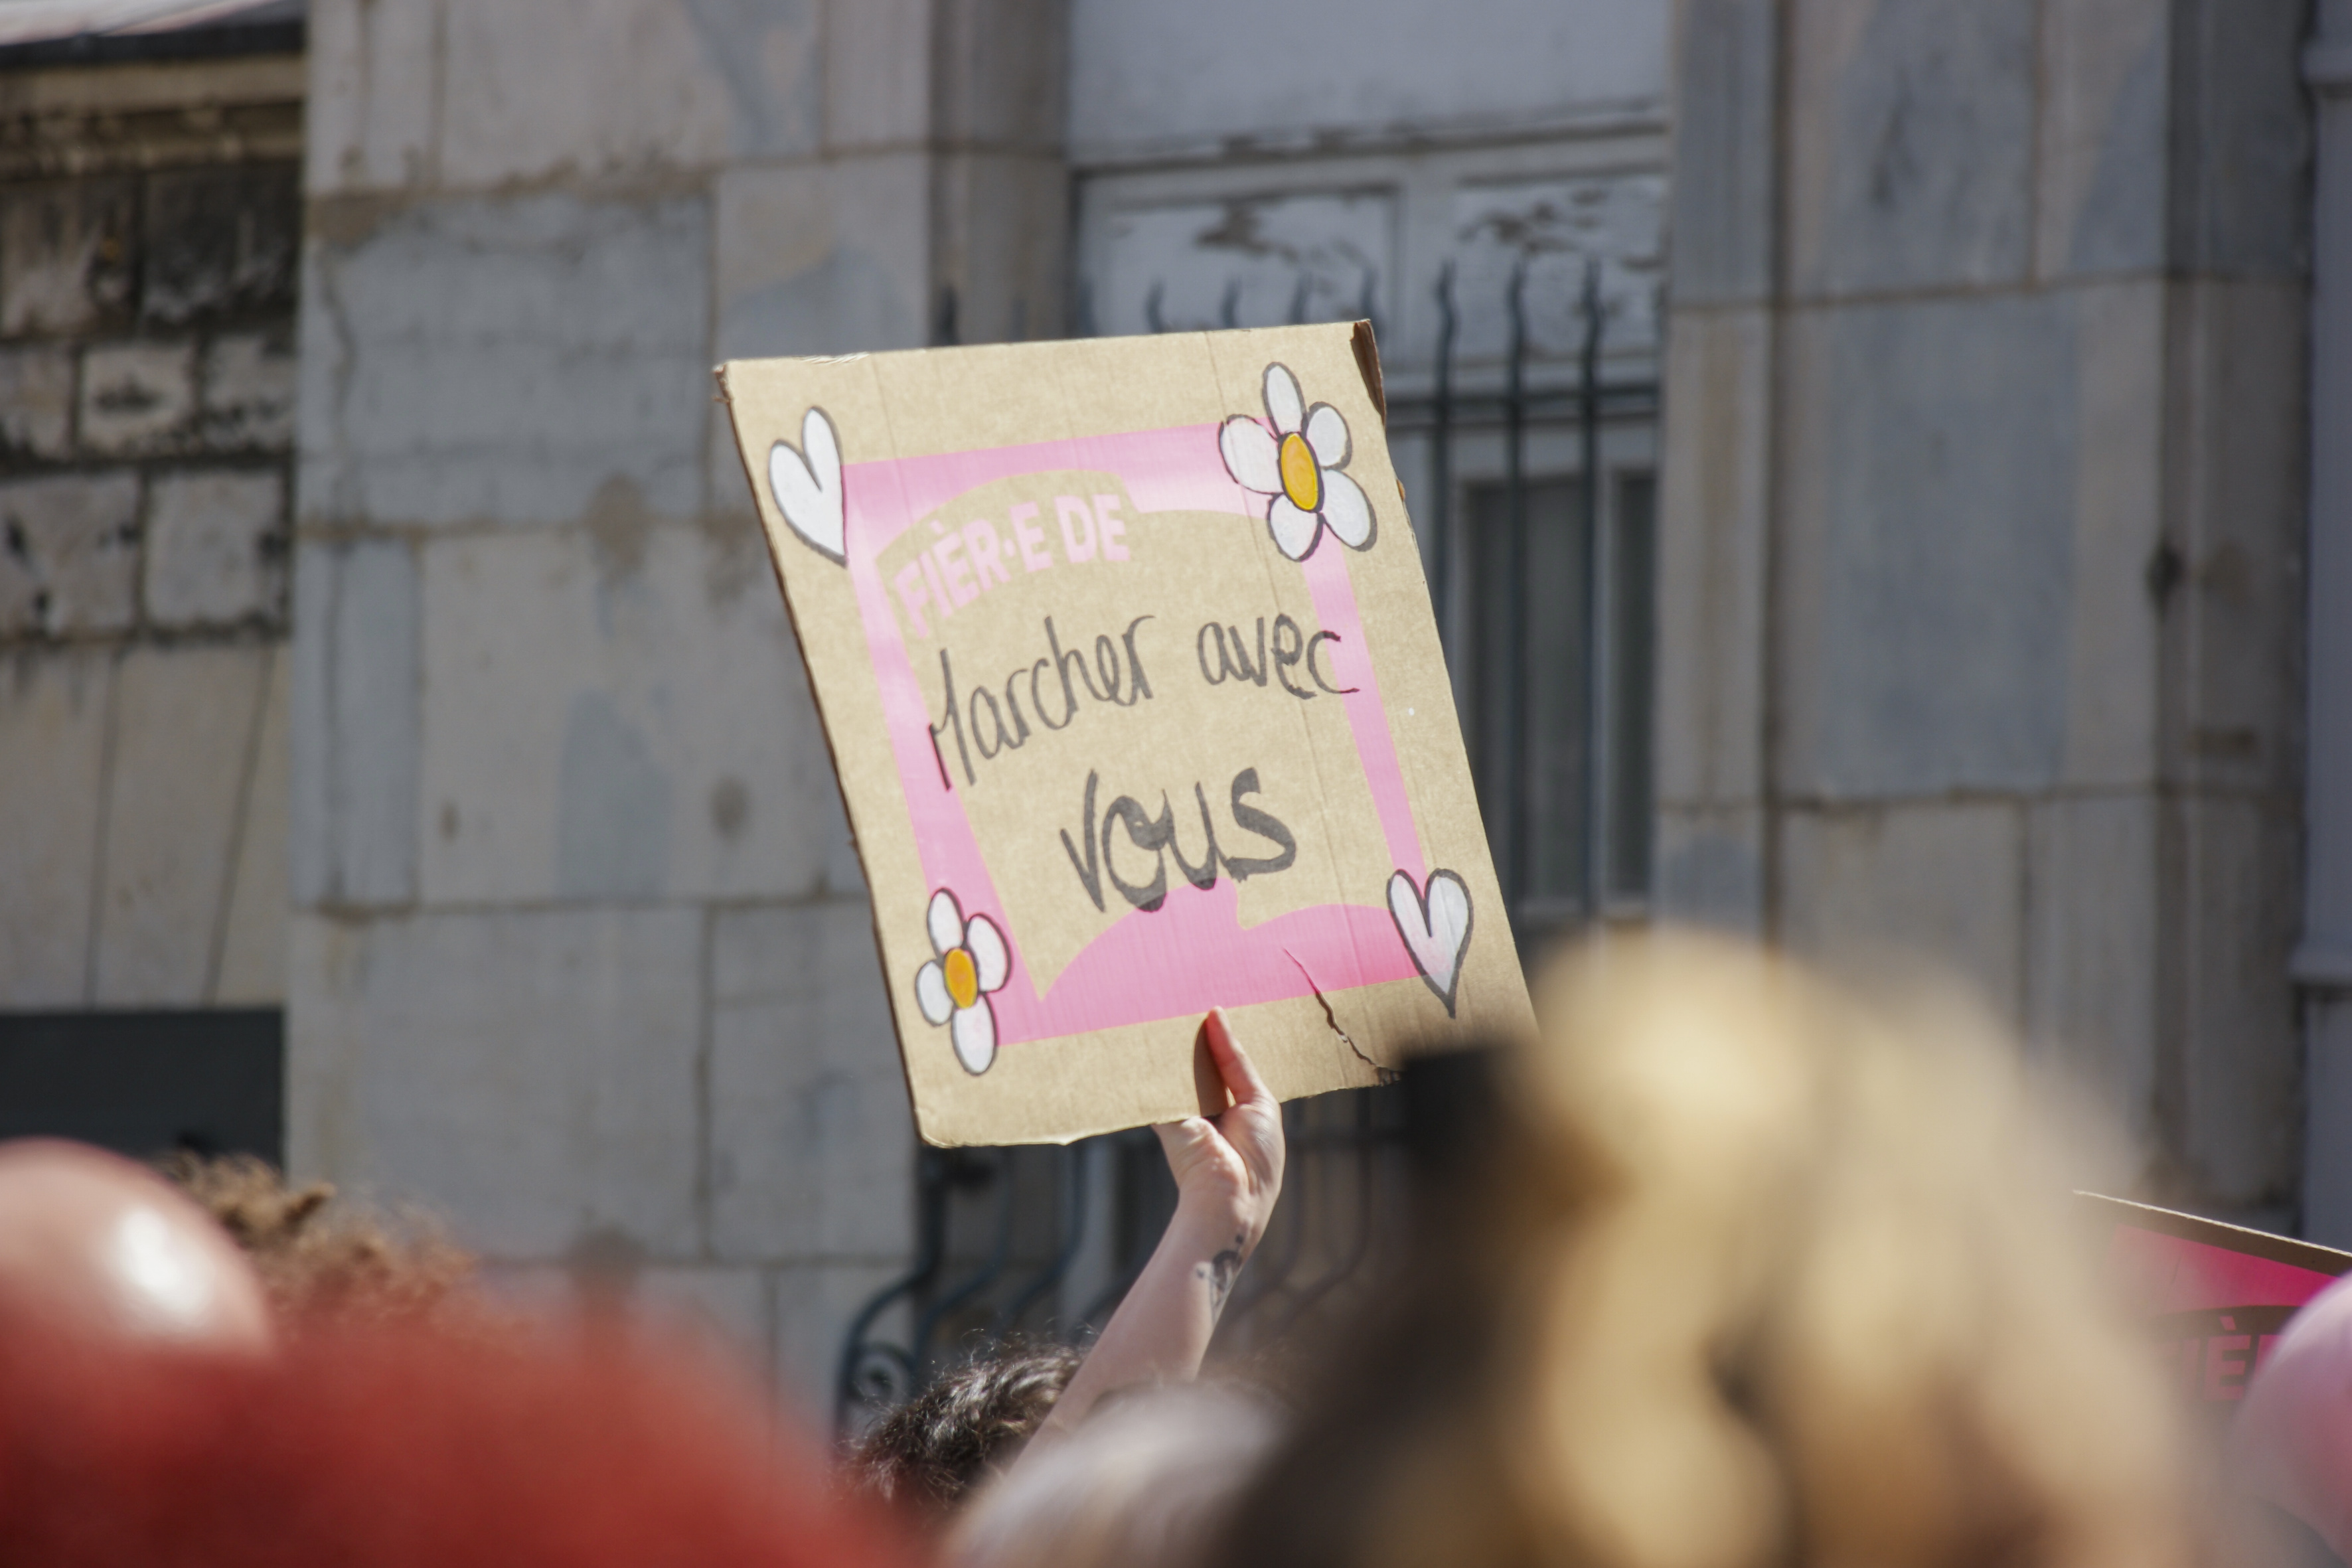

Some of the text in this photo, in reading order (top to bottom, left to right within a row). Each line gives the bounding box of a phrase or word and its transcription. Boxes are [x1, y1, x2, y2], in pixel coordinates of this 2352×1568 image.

[1054, 494, 1131, 564] DE
[927, 613, 1361, 791] Marcher avec
